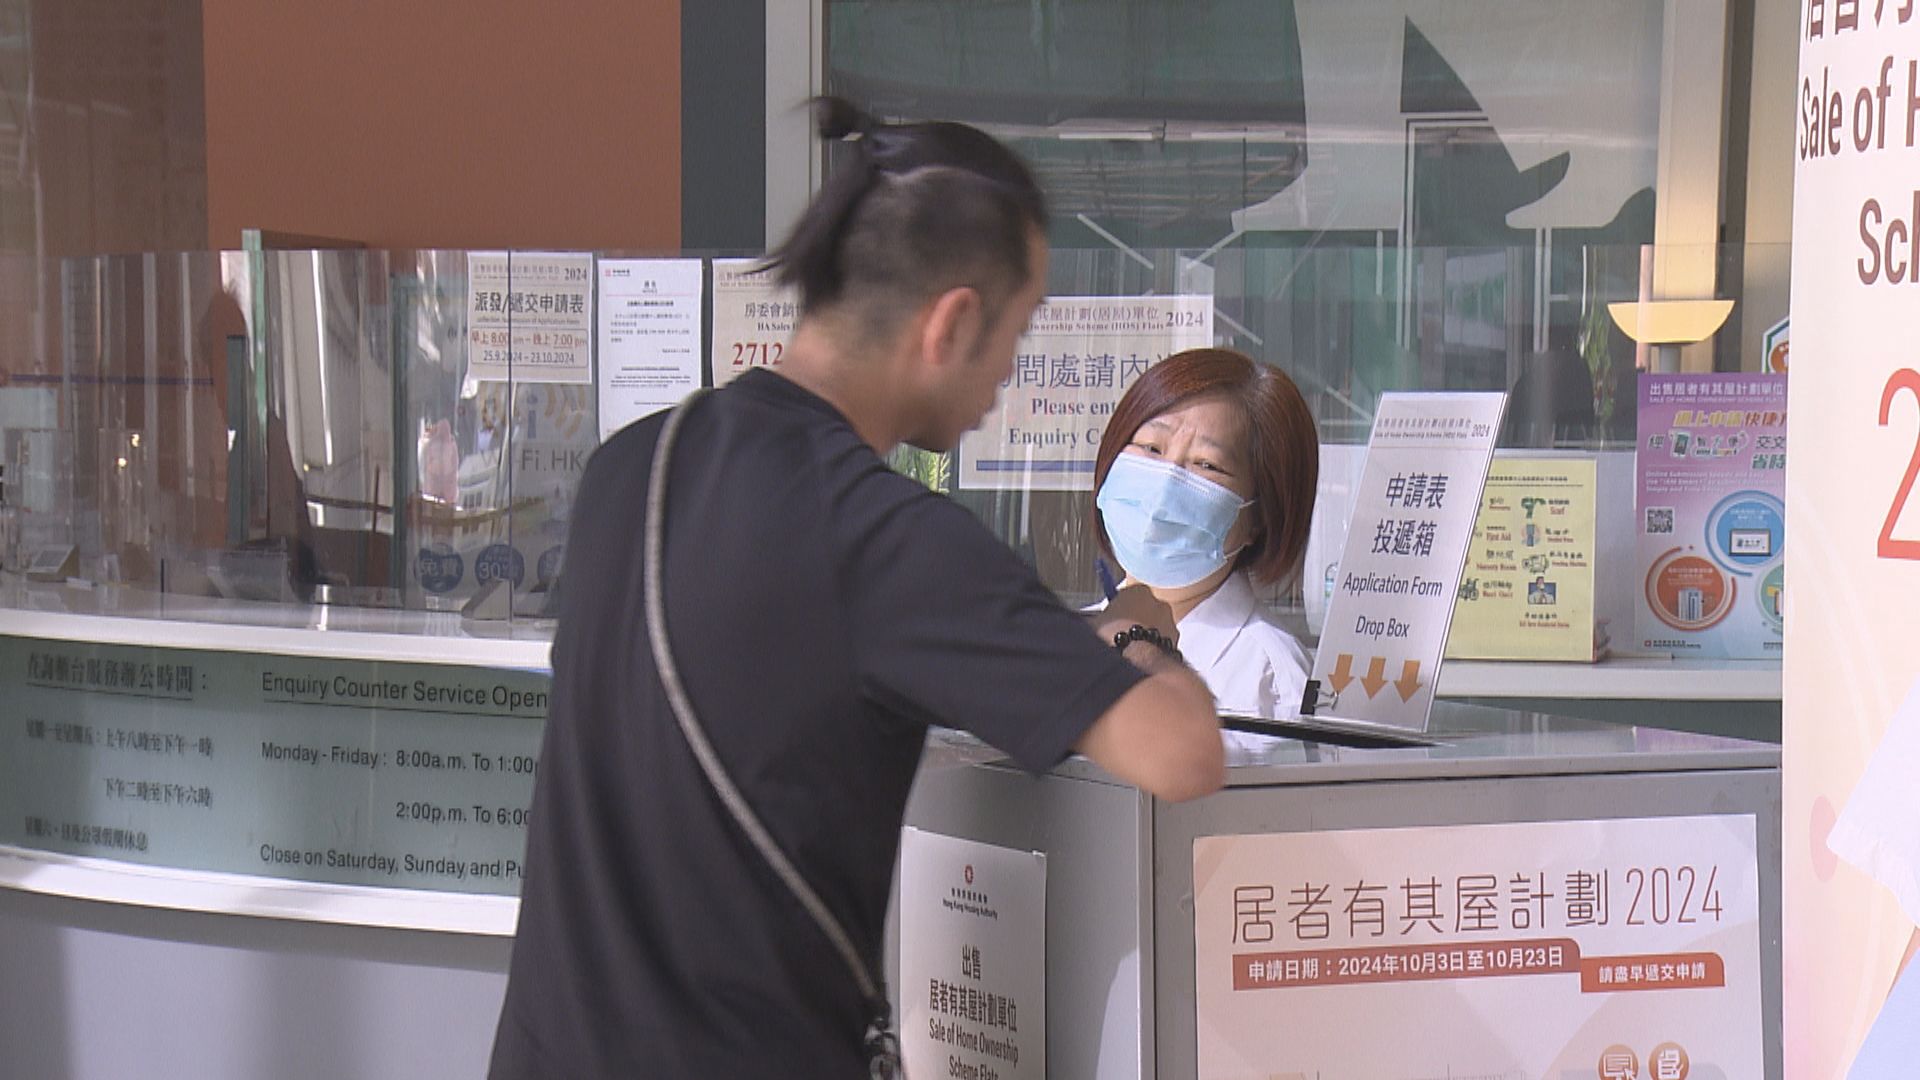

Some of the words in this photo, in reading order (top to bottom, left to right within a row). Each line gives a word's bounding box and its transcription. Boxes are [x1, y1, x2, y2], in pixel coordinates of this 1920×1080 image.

[1801, 66, 1843, 161] Sale
[1853, 55, 1894, 153] of
[564, 267, 588, 280] 2024
[757, 322, 770, 332] HA
[1076, 322, 1109, 331] Scheme
[1142, 321, 1165, 331] Flats
[1165, 311, 1205, 328] 2024
[732, 342, 784, 366] 2712
[1032, 397, 1085, 415] Please
[1009, 428, 1079, 449] Enquiry
[1386, 472, 1448, 509] 申請表
[1371, 518, 1437, 557] 投遞箱
[1343, 572, 1408, 597] Application
[1411, 576, 1443, 597] Form
[1355, 615, 1385, 640] Drop
[1386, 617, 1410, 638] Box
[262, 671, 328, 700] Enquiry
[333, 675, 407, 700] Counter
[413, 680, 486, 706] Service
[262, 741, 318, 766] Monday
[396, 749, 466, 770] 8:00a.m.
[472, 752, 490, 771] To
[498, 756, 538, 779] 1:00
[396, 802, 467, 823] 2:00p.m.
[473, 806, 491, 824] To
[260, 844, 301, 865] Close
[303, 850, 323, 866] on
[327, 850, 399, 875] Saturday,
[404, 854, 465, 880] Sunday
[469, 861, 500, 878] and
[1232, 868, 1609, 944] 居者有其屋計劃
[1625, 865, 1723, 926] 2024
[962, 944, 981, 980] 出售
[1248, 945, 1563, 983] 申請日期：2024年10月3日至10月23日
[1599, 961, 1705, 984] 請盡早遞交申請
[930, 978, 1017, 1033] 居者有其屋計劃單位
[929, 1017, 946, 1042] Sale
[947, 1021, 955, 1045] of
[956, 1024, 978, 1052] Home
[979, 1031, 1019, 1069] Ownership
[949, 1053, 978, 1080] Scheme
